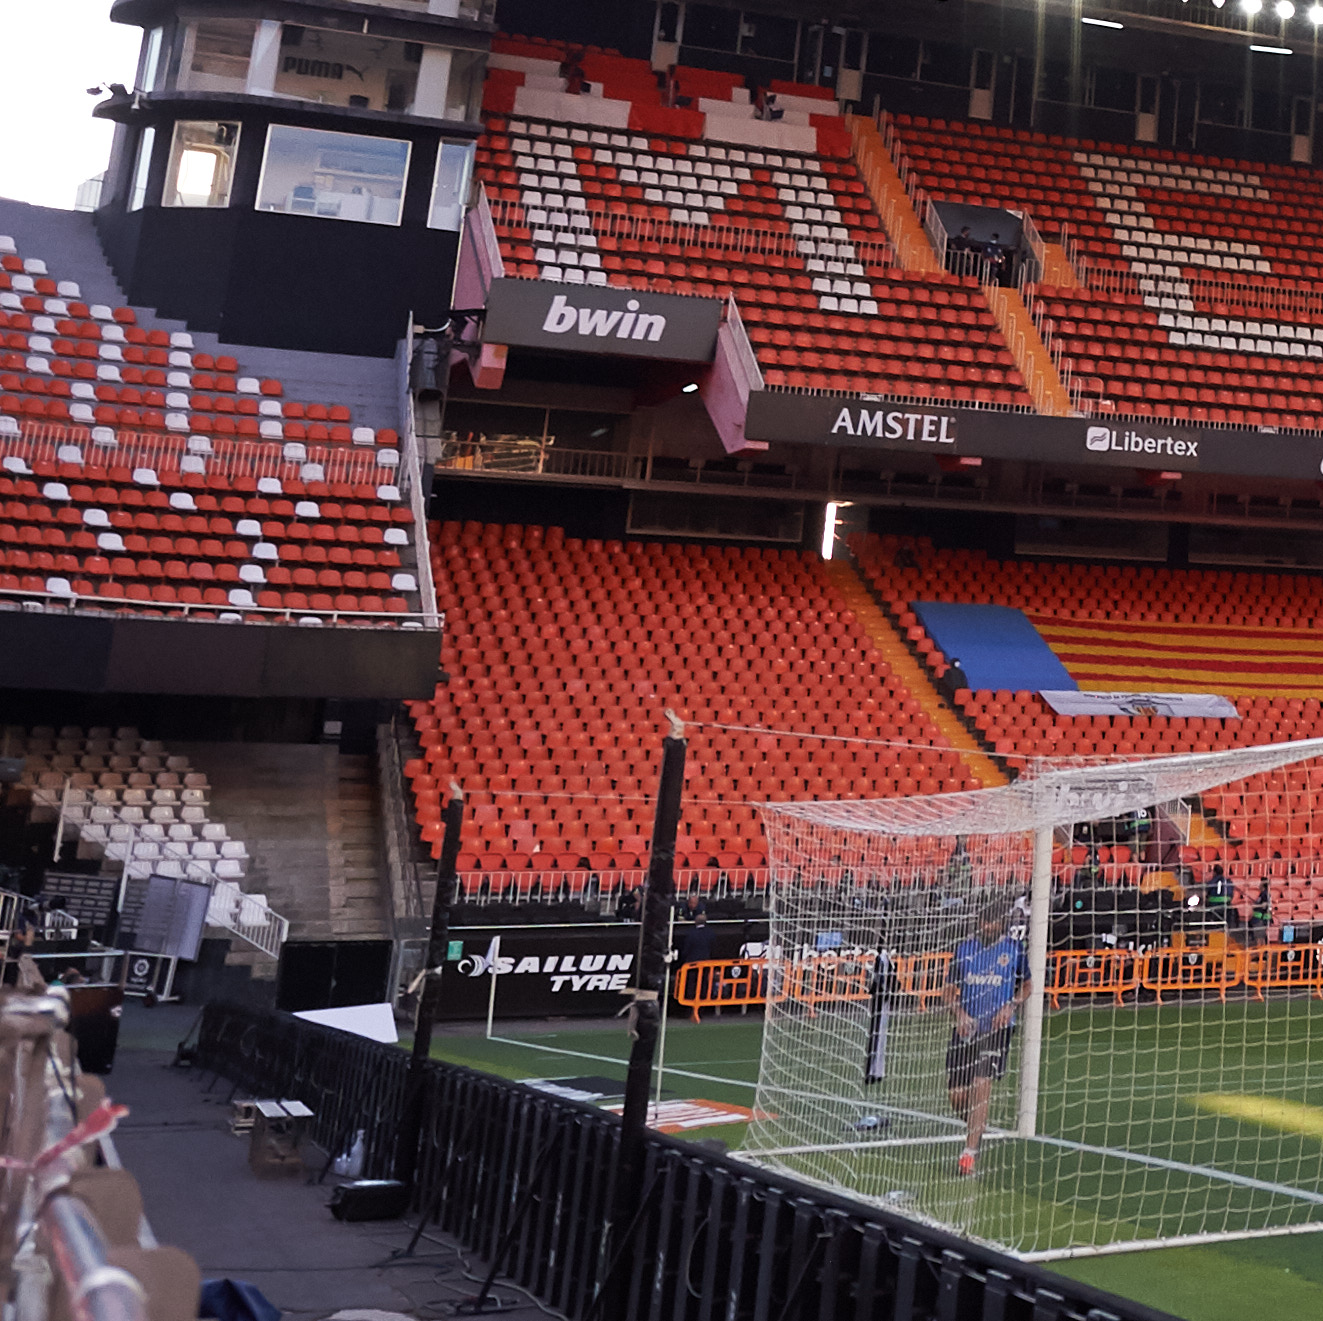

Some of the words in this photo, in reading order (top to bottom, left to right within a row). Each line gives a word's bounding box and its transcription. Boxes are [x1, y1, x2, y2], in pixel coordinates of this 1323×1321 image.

[542, 295, 666, 341] bwin
[831, 407, 955, 443] AMSTEL
[1110, 431, 1199, 457] Libertex
[488, 953, 634, 975] SAILUN
[550, 973, 632, 993] TYRE
